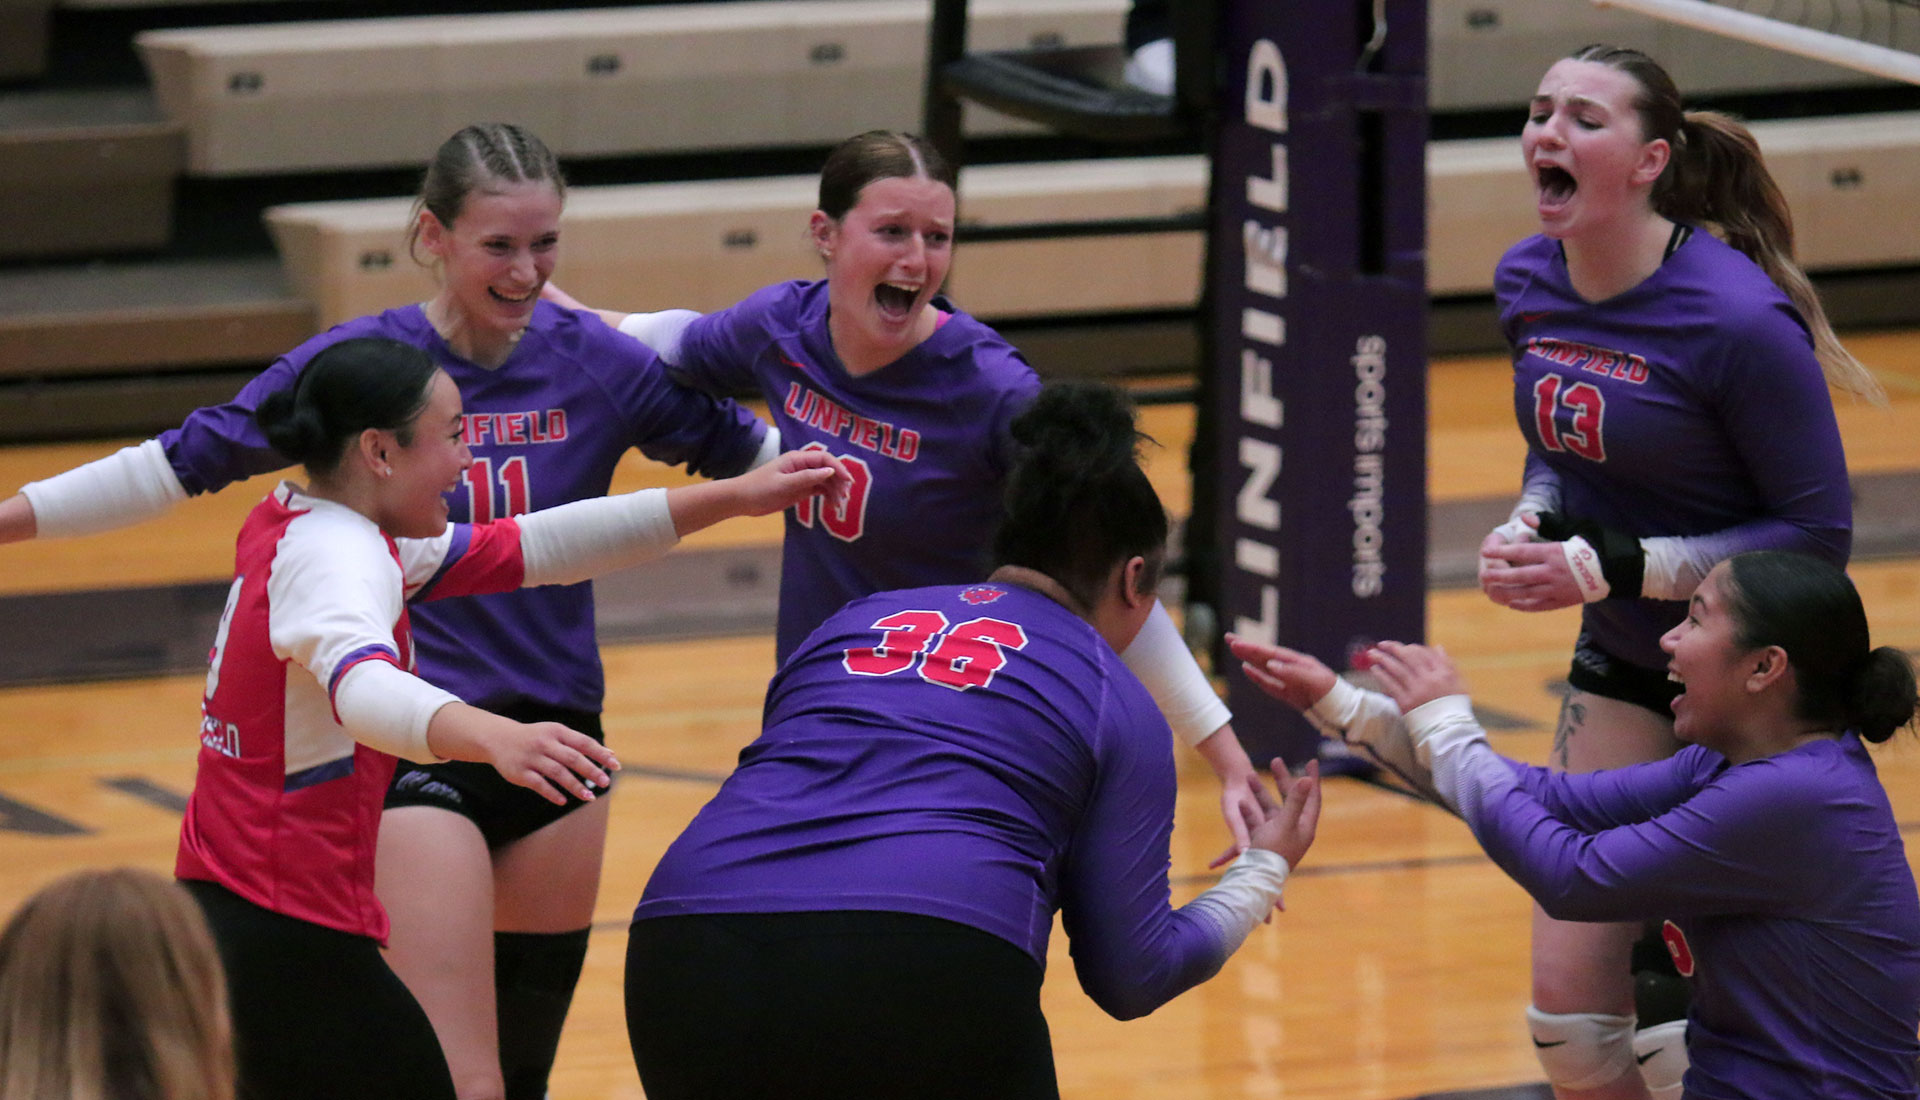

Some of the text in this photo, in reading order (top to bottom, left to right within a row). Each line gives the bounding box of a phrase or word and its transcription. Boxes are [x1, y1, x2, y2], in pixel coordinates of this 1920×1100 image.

[1233, 39, 1289, 647] LINFIELD
[460, 408, 569, 446] FIELD
[784, 381, 921, 463] LINFIELD
[1533, 372, 1607, 463] 13
[462, 456, 531, 525] 11
[1347, 334, 1388, 598] sports imports
[842, 610, 1029, 692] 36
